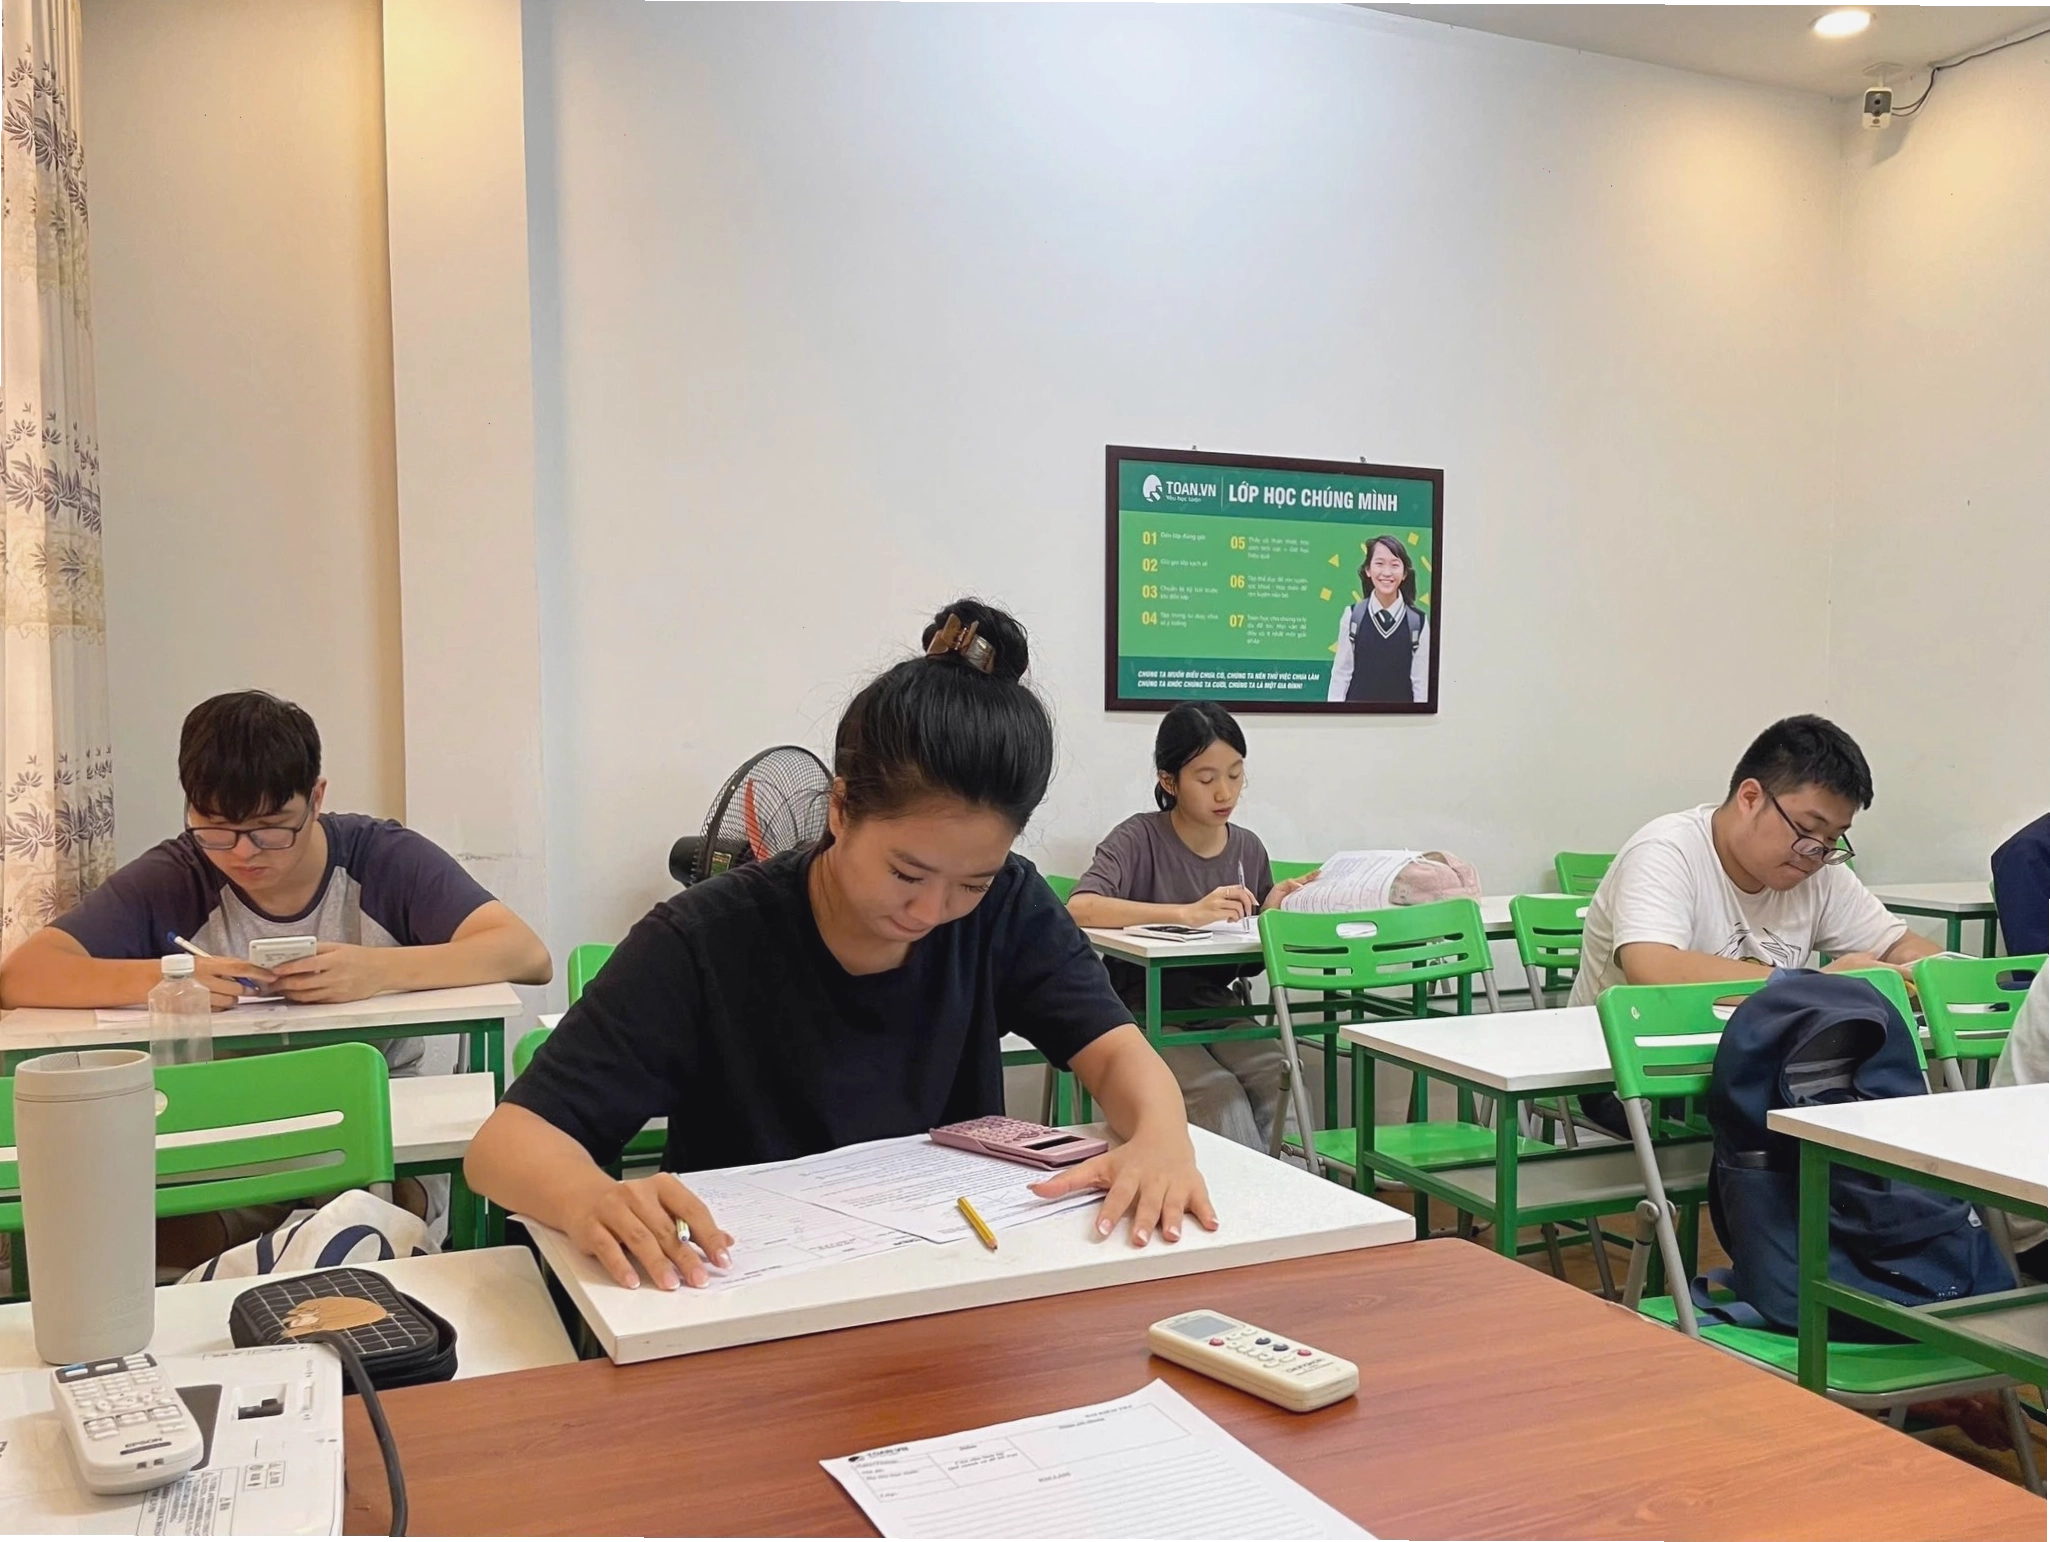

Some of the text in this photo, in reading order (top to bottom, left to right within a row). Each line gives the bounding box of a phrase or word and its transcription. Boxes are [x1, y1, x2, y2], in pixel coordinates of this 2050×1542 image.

[1165, 481, 1217, 497] TOAN.VN
[1228, 480, 1398, 512] LỚP HỌC CHÚNG MÌNH
[1142, 531, 1157, 545] 01
[1230, 536, 1246, 549] 05
[1142, 558, 1158, 572] 02
[1230, 575, 1245, 588] 06
[1142, 585, 1158, 599] 03
[1142, 611, 1158, 625] 04
[1230, 614, 1245, 627] 07
